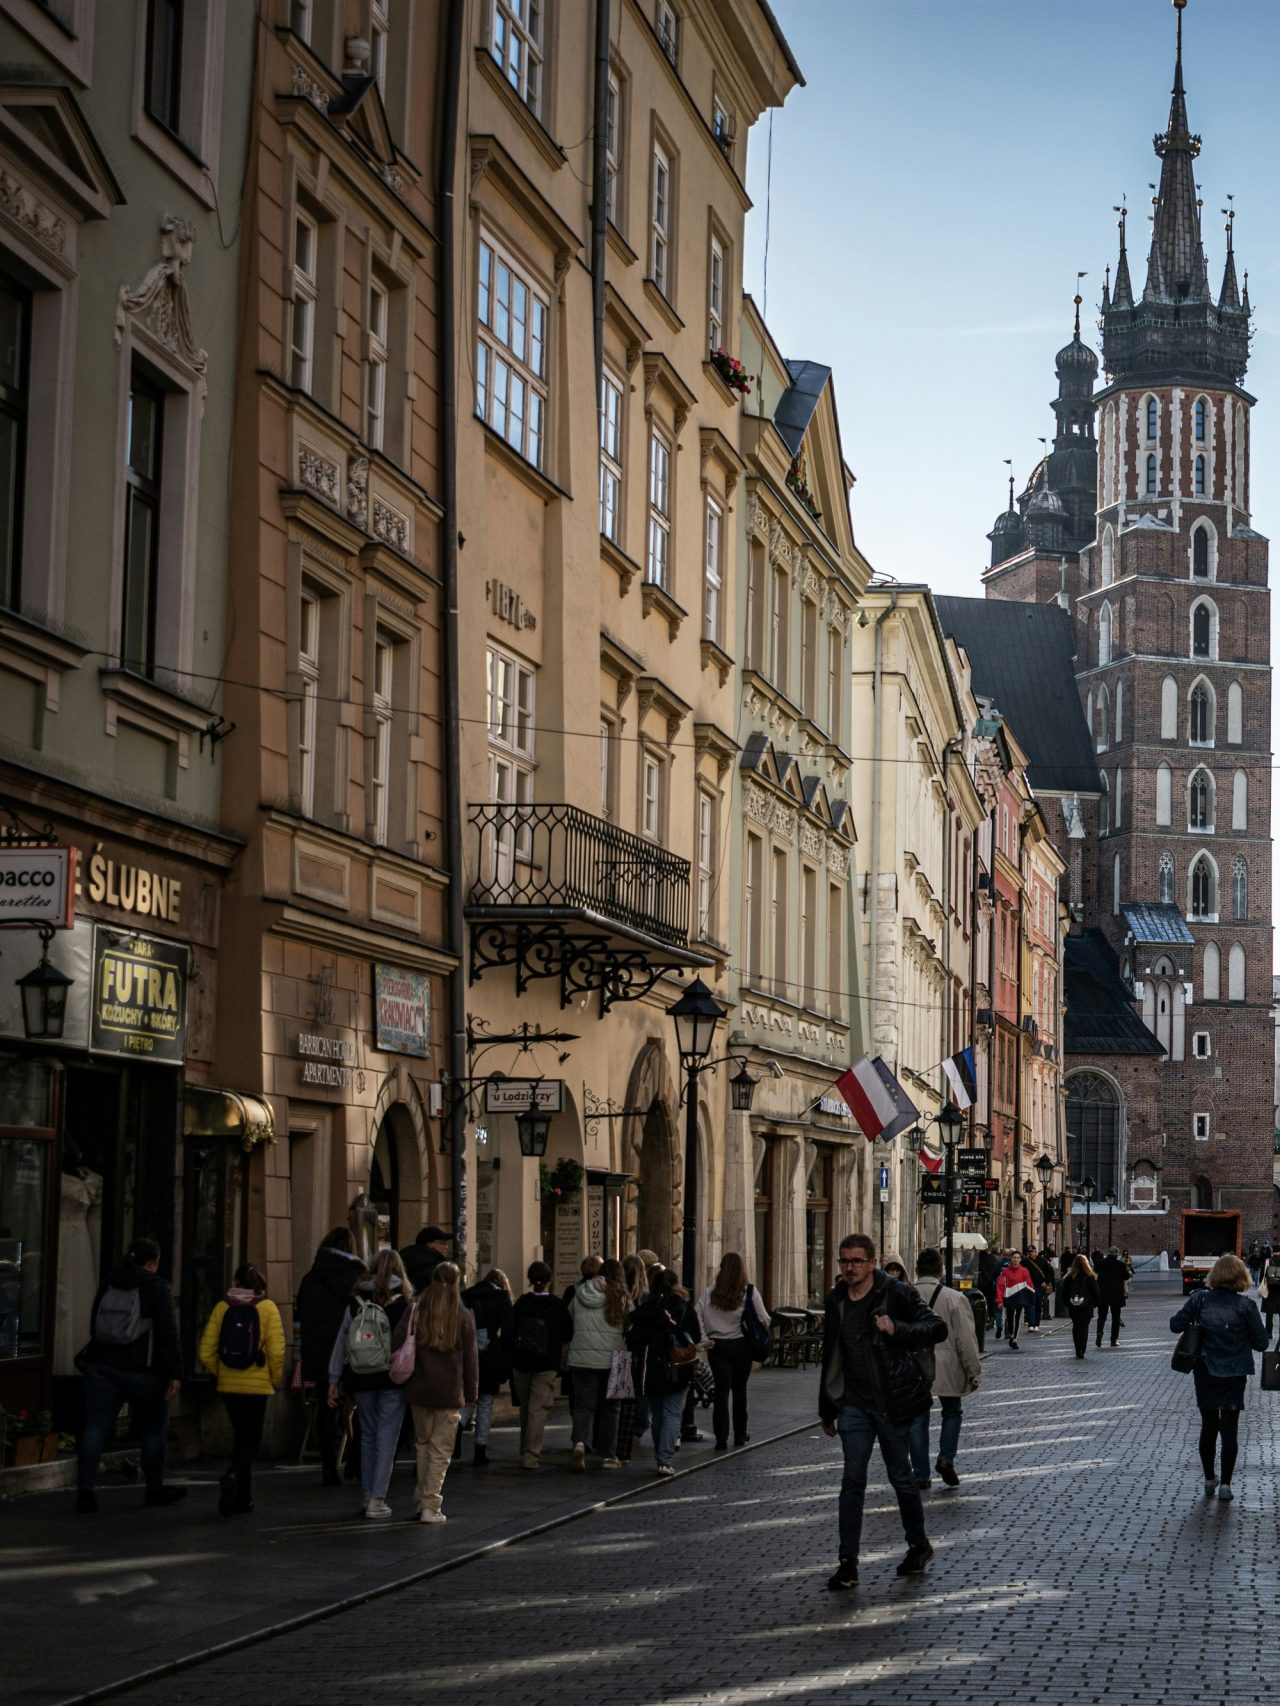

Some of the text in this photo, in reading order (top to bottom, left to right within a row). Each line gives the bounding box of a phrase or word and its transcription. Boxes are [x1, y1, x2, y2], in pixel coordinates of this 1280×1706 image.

[89, 842, 182, 923] ŚLUBNE
[103, 959, 178, 1011] FUTRA
[102, 1001, 178, 1032] KOŻUCHY SKÓRY
[129, 1036, 154, 1053] PIĘTRO
[299, 1033, 332, 1058] BARBICAN
[303, 1061, 352, 1087] APARTMENTS
